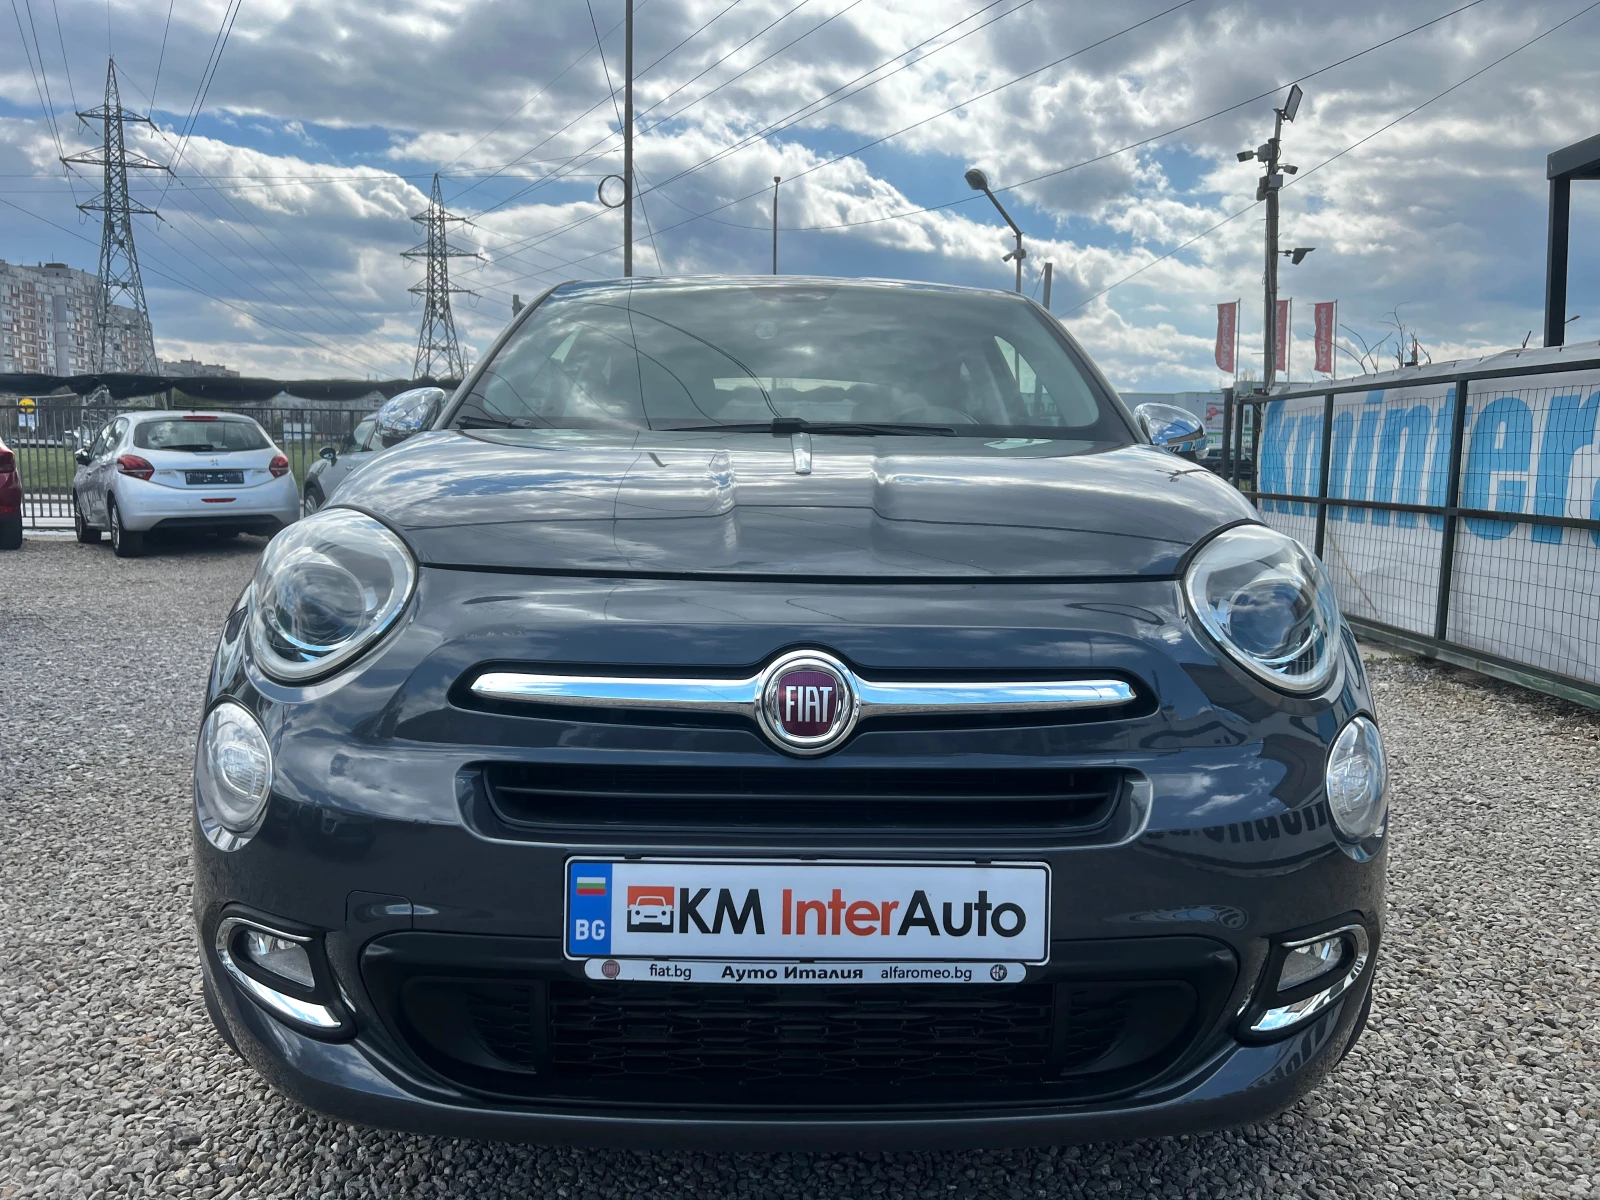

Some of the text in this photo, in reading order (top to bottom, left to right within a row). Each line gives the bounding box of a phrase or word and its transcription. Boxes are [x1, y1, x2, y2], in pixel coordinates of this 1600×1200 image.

[1259, 388, 1600, 547] kminter
[785, 686, 833, 722] FIAT
[679, 887, 1026, 938] KM InterAuto
[575, 919, 606, 941] BG
[649, 964, 692, 981] fiat.bg
[784, 967, 863, 980] Италия
[881, 966, 972, 981] alfaromeo.bg
